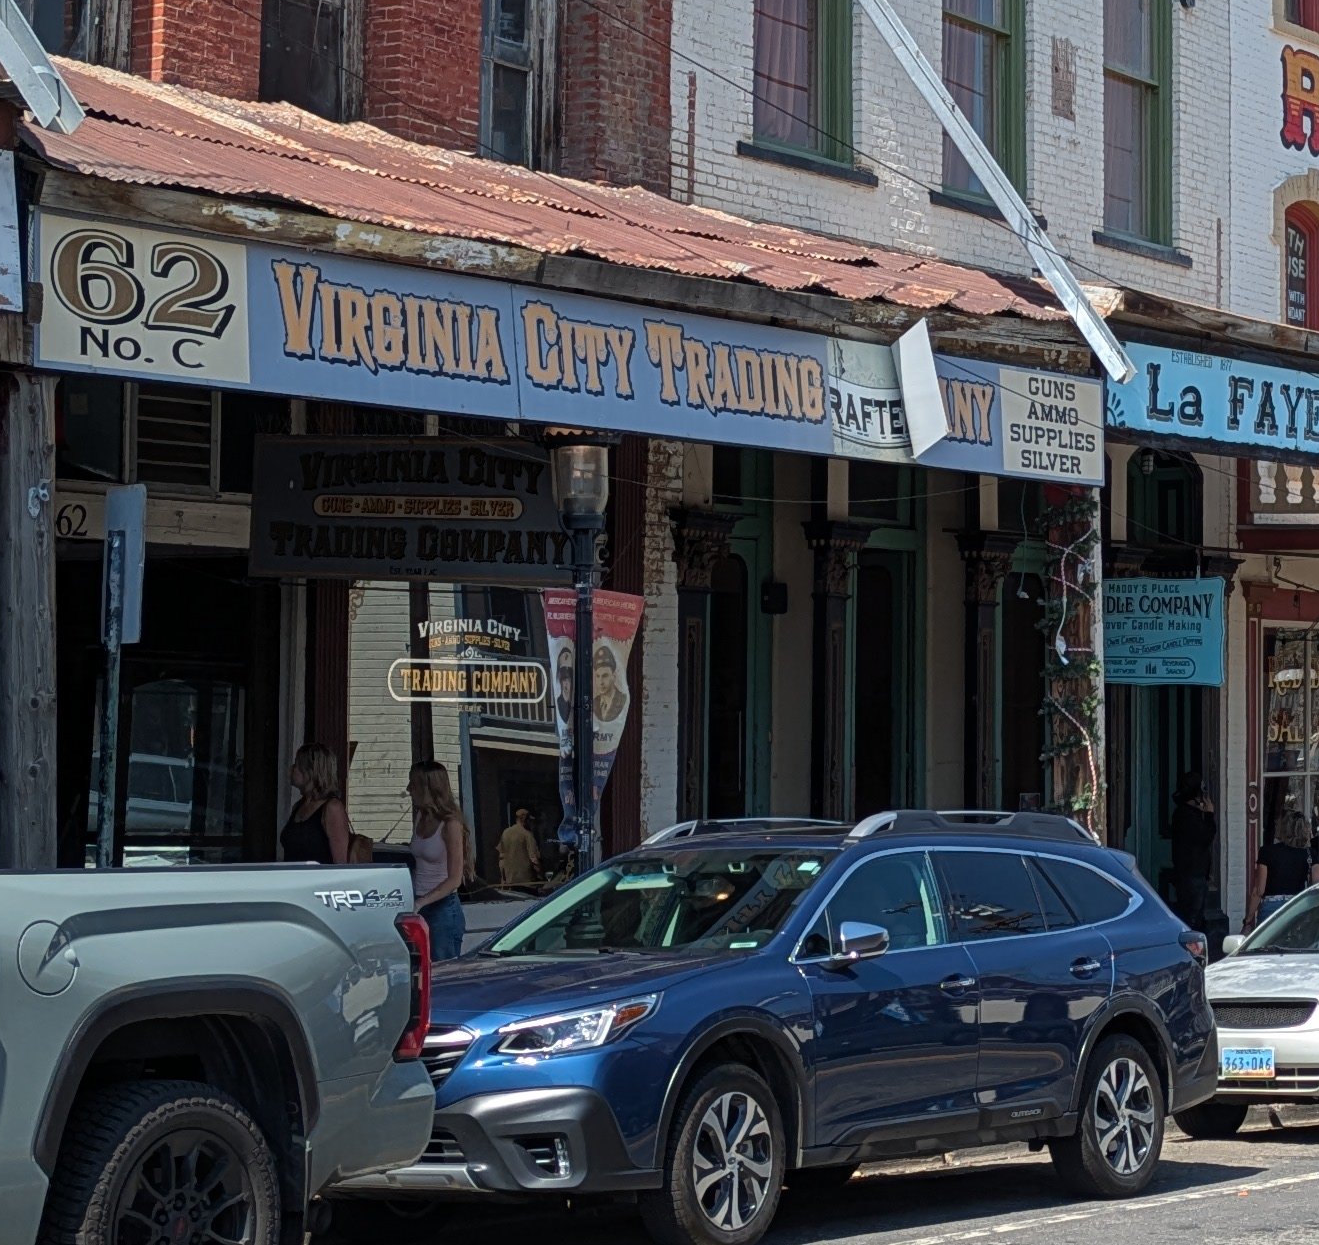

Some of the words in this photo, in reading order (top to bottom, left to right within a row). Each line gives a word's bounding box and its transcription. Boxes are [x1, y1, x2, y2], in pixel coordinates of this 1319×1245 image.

[50, 229, 236, 338] 62
[172, 339, 204, 368] C
[271, 259, 511, 385] VIRGINIA
[520, 299, 635, 400] CITY
[643, 318, 828, 424] TRADING
[1171, 350, 1213, 368] ESTABLISHED
[1027, 376, 1076, 402] GUNS
[1146, 362, 1204, 426] La
[1027, 401, 1080, 426] AMMO
[1009, 423, 1096, 454] SUPPLIES
[299, 449, 449, 491] VIRGINIA
[458, 447, 545, 495] CITY
[1020, 449, 1081, 475] SILVER
[56, 504, 88, 536] 62
[404, 499, 461, 516] SUPPLIES
[270, 522, 407, 560] TRADING
[416, 525, 573, 565] COMPANY
[1152, 584, 1180, 594] PLACE
[1139, 594, 1214, 620] COMPANY
[418, 618, 483, 638] VIRGINIA
[487, 618, 521, 641] CITY
[1132, 620, 1164, 630] Candle
[1168, 620, 1202, 633] Making
[400, 669, 467, 692] TRADING
[473, 671, 538, 694] COMPANY
[314, 889, 364, 910] TRD
